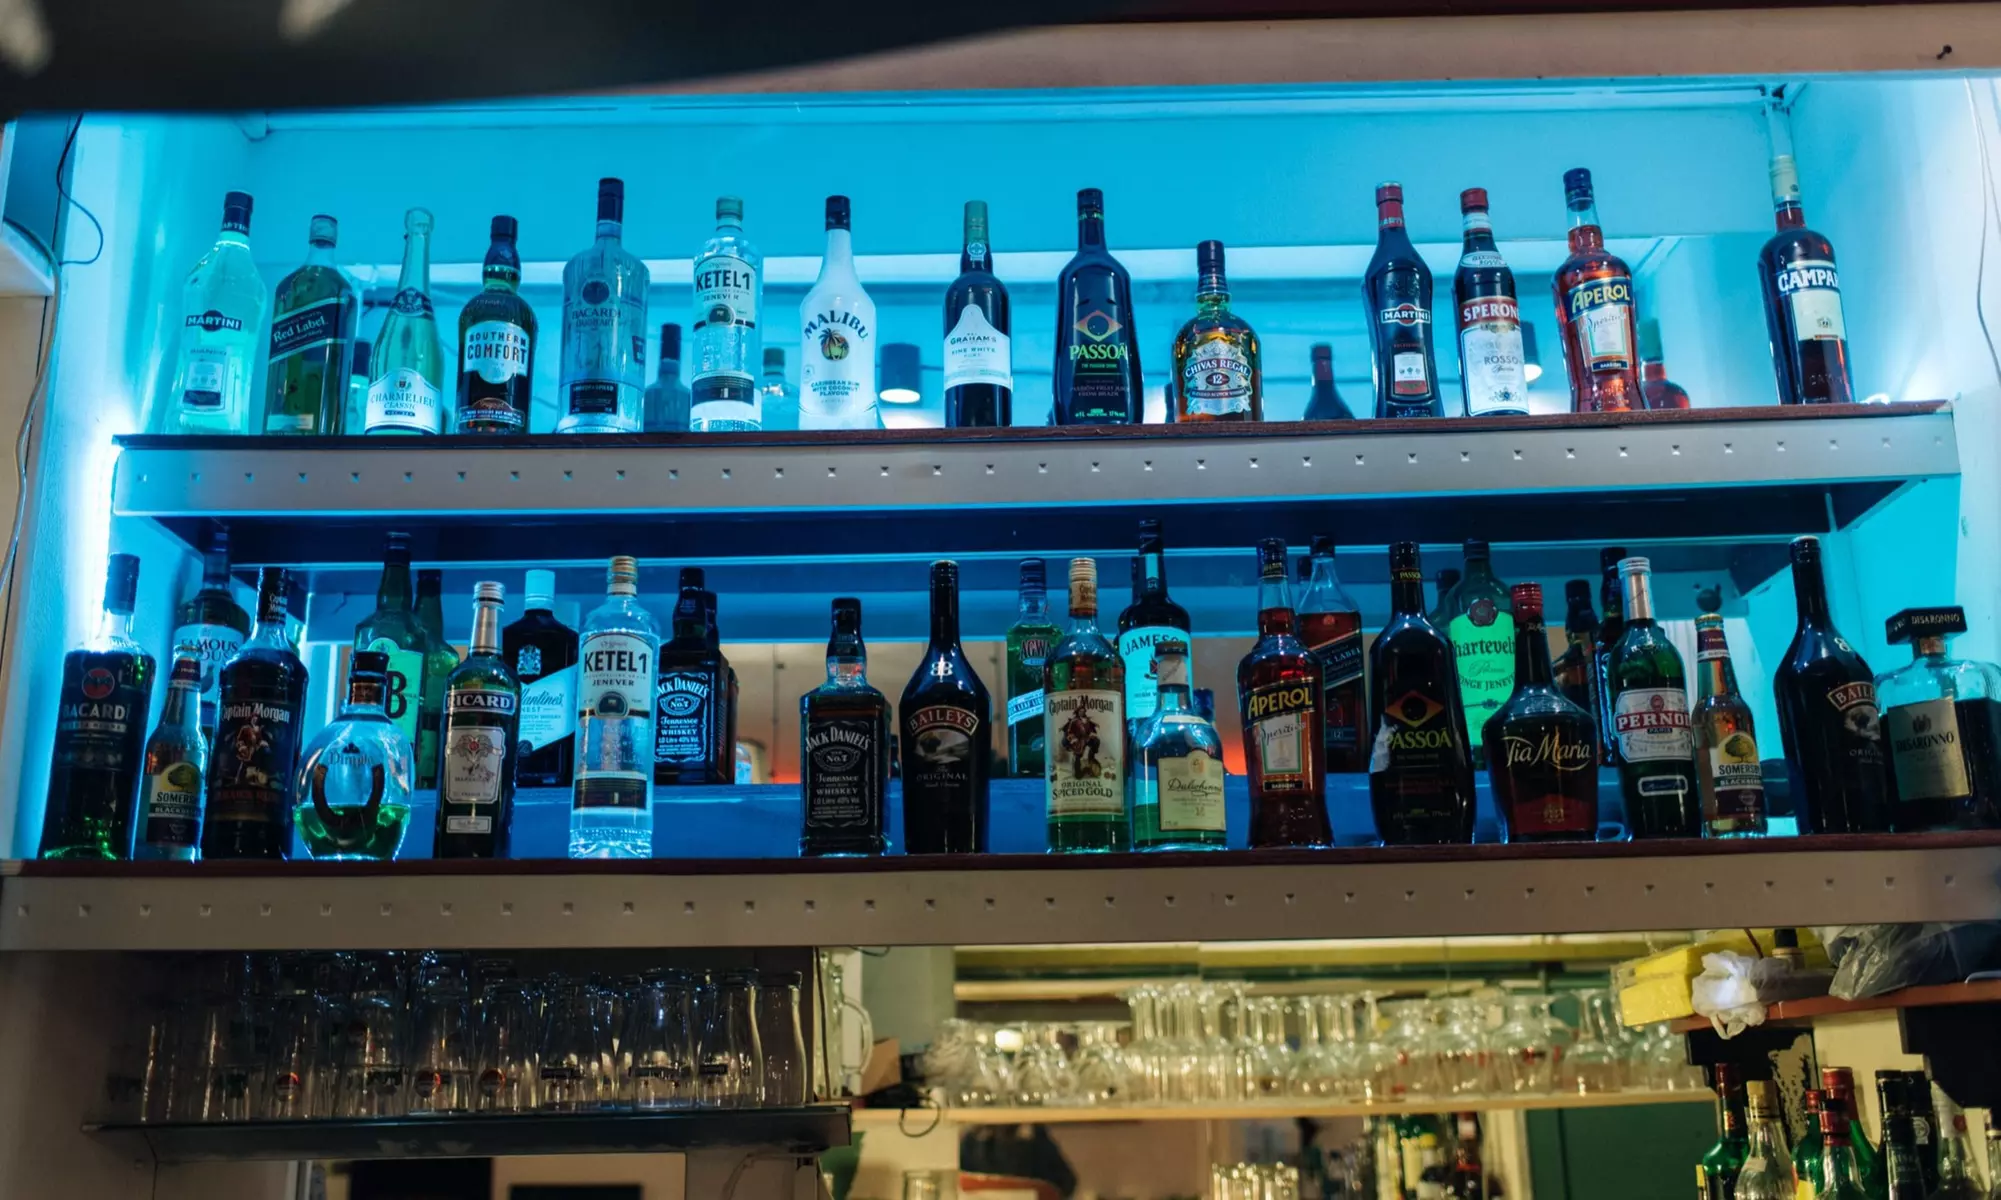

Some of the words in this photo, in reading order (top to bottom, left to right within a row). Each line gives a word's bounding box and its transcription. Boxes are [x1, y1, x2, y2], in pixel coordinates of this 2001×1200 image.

[1570, 284, 1630, 315] APEROL
[572, 307, 622, 320] BACARDI
[1383, 310, 1428, 321] MARTINI
[1463, 302, 1519, 322] SPERON
[187, 315, 241, 331] MARTINI
[273, 327, 294, 343] Red
[297, 315, 327, 335] Label
[804, 309, 869, 340] MALIBU
[468, 331, 527, 347] SOUTHERN
[467, 343, 528, 365] COMFORT
[1483, 355, 1519, 366] ROSSO
[1184, 360, 1217, 378] CHIVAS
[1219, 360, 1249, 377] REGAL
[1212, 373, 1223, 385] 12
[828, 385, 859, 393] COCONUT
[370, 391, 436, 409] CHARMELIEU
[1911, 613, 1961, 626] DISARONNO
[592, 679, 634, 687] JENEVER
[657, 681, 675, 696] ACK
[673, 677, 710, 699] DANIEL'S
[1460, 676, 1481, 690] ONGE
[520, 688, 565, 708] llantine's
[1247, 687, 1313, 720] APEROL
[1834, 684, 1876, 705] BAILE
[63, 702, 132, 721] BACARDI
[220, 703, 251, 722] Captain
[252, 702, 290, 724] Morgan
[1048, 698, 1078, 717] Captain
[1077, 695, 1114, 714] Morgan
[660, 716, 698, 725] Tennessee
[909, 708, 974, 732] BAILEYS
[805, 731, 831, 753] JACK
[830, 725, 873, 752] DANIEL'S
[1895, 731, 1955, 753] DISARONNO
[1501, 736, 1536, 767] Tia
[1531, 732, 1592, 769] Maria
[815, 773, 860, 783] Tennessee
[916, 772, 969, 783] ORIGINAL
[1061, 780, 1104, 788] ORIGINAL
[156, 791, 196, 804] SOMER
[816, 787, 858, 796] WHISKEY
[1052, 787, 1084, 801] SPICED
[1085, 787, 1113, 799] GOLD
